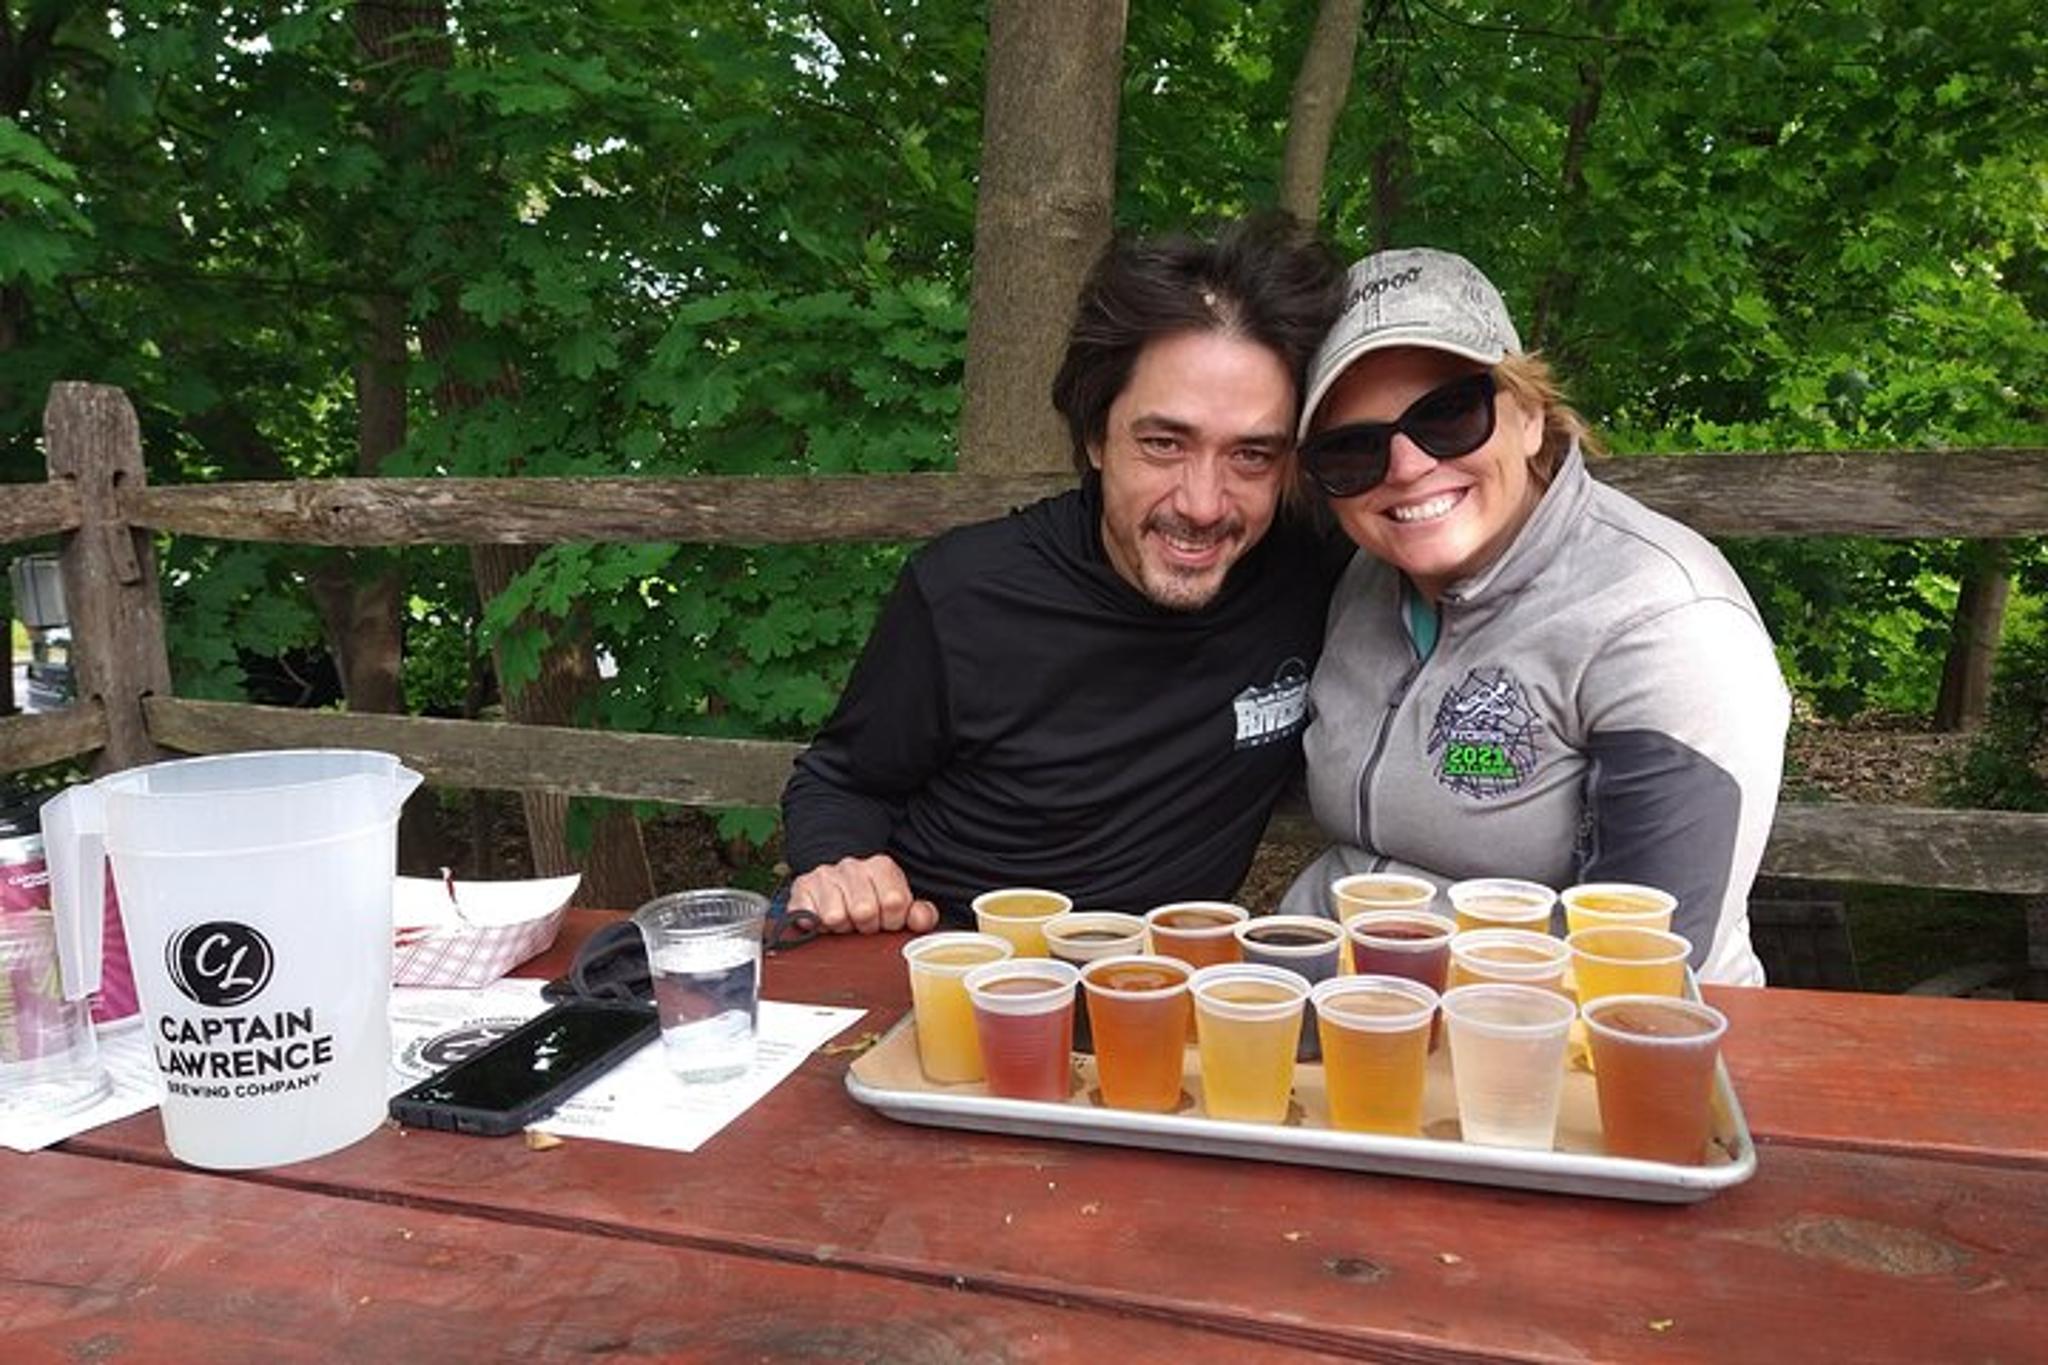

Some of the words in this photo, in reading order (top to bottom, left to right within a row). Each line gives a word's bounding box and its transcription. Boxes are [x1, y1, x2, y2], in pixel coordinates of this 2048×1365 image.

[1450, 744, 1504, 766] 2021
[196, 933, 254, 990] CL
[160, 1006, 312, 1044] CAPTAIN
[155, 1035, 333, 1078] LAWRENCE
[167, 1080, 230, 1098] BREWING
[235, 1072, 321, 1098] COMPANY
